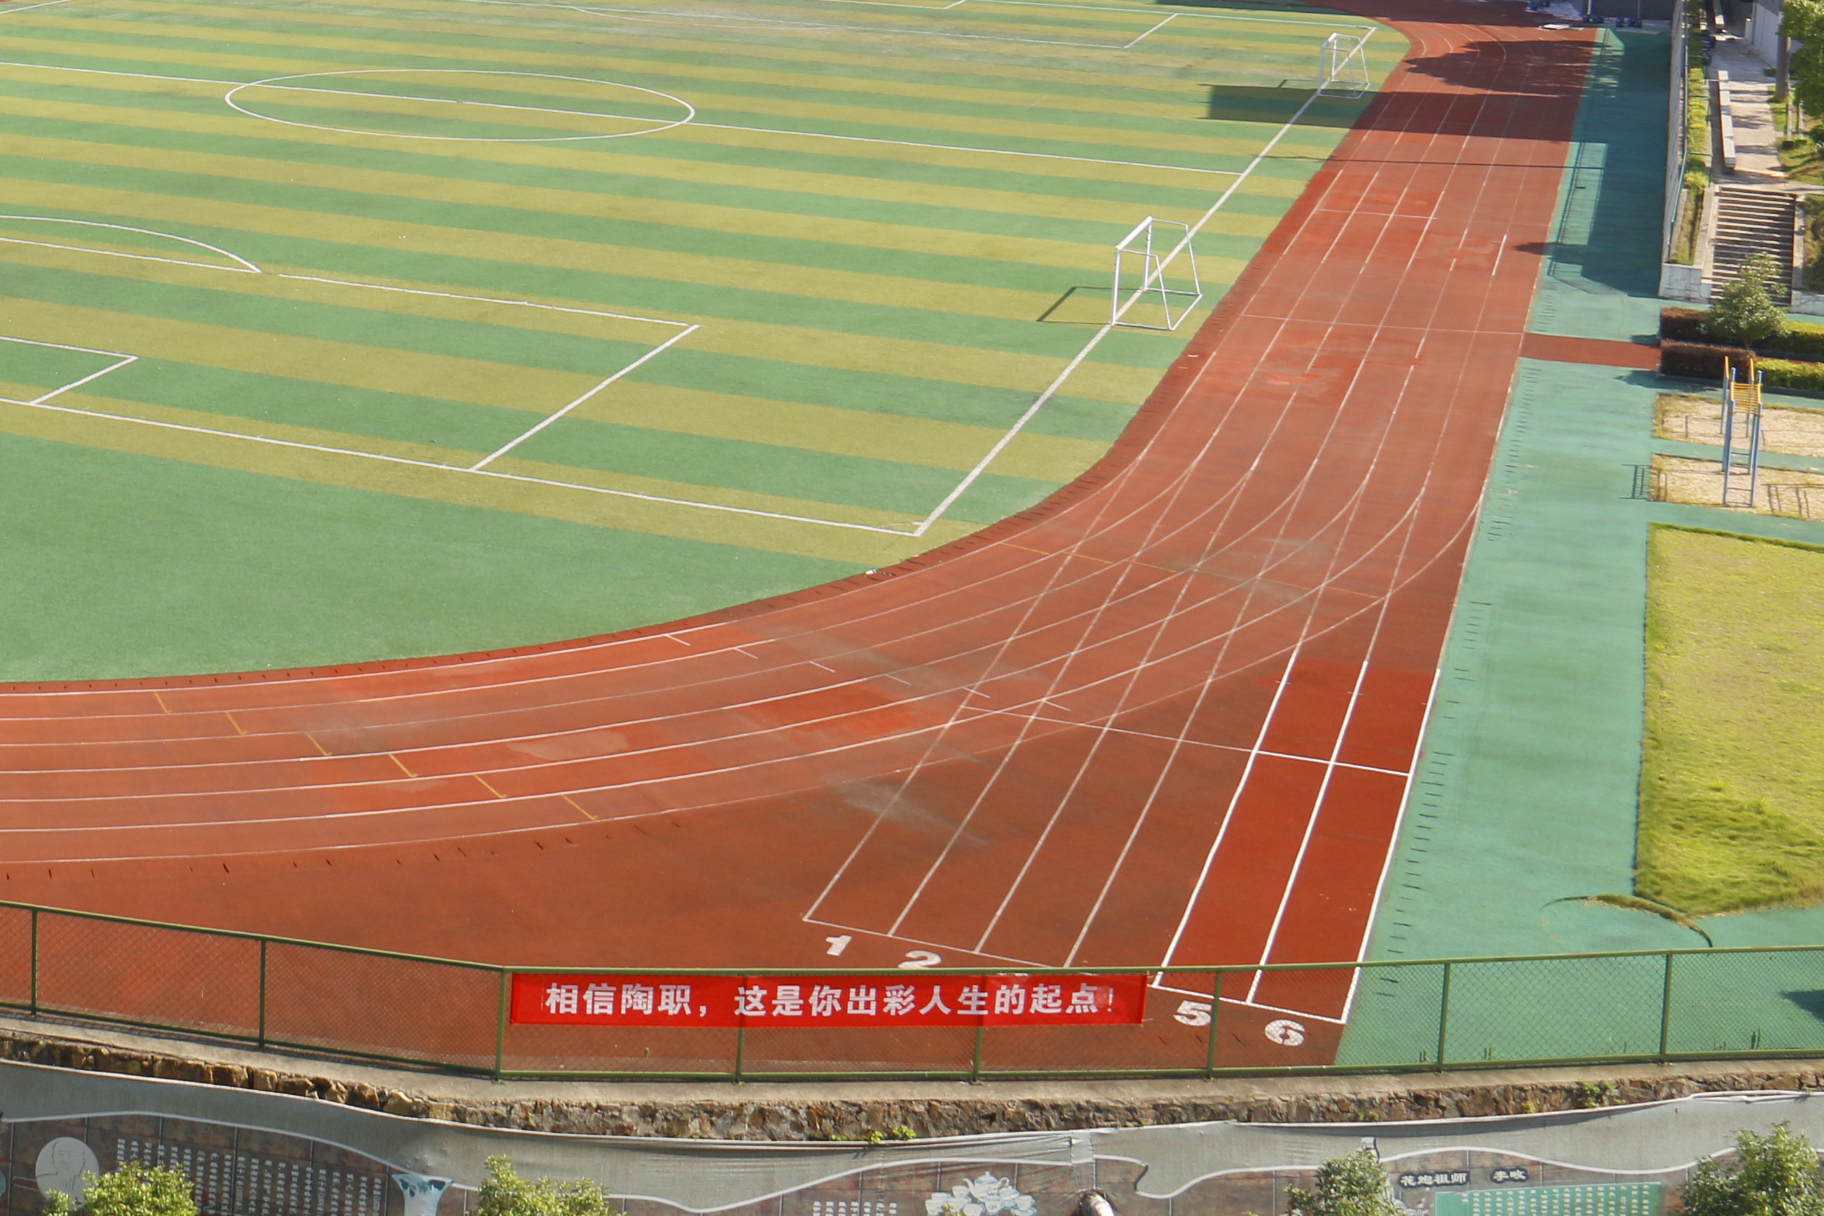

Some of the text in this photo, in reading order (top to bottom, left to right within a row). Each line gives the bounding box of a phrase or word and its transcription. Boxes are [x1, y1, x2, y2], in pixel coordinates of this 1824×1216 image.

[825, 934, 852, 956] 1
[897, 950, 942, 969] 2
[1173, 1000, 1212, 1026] 5
[1264, 1019, 1306, 1046] 6
